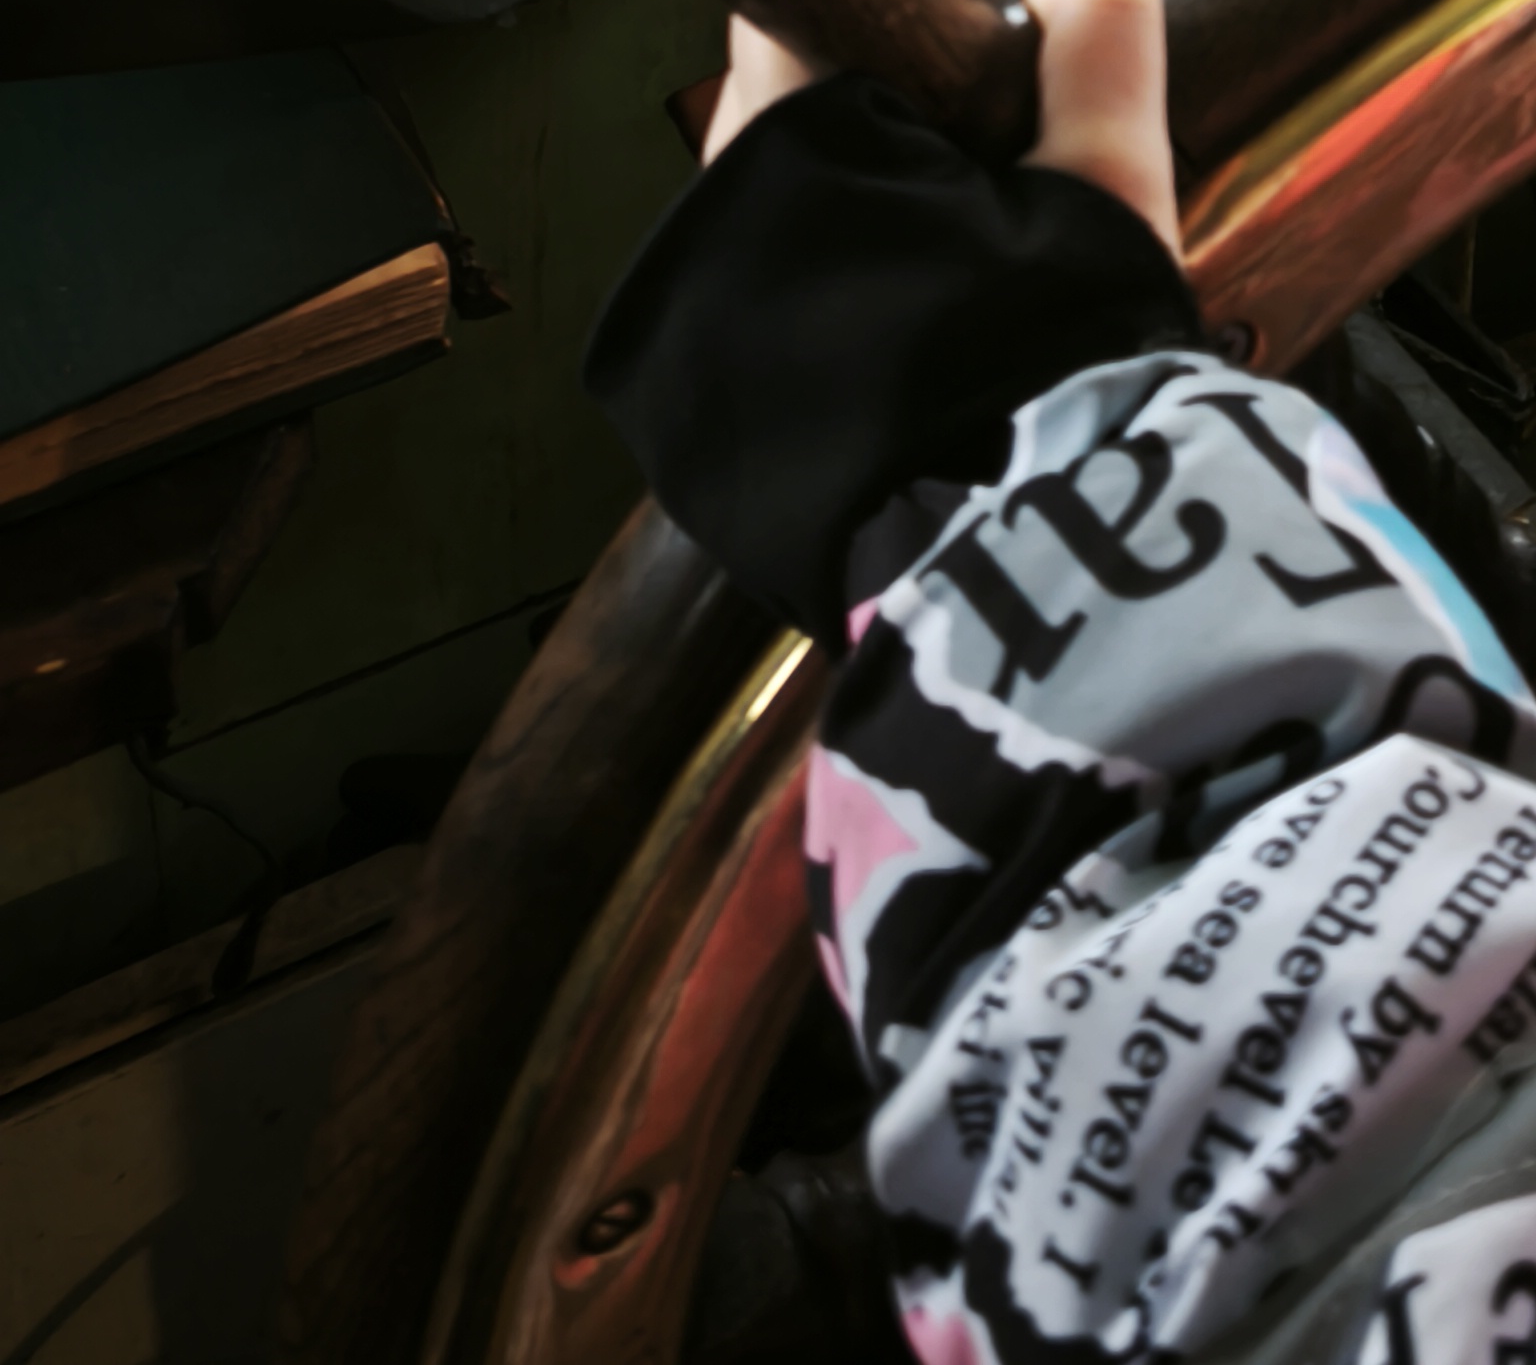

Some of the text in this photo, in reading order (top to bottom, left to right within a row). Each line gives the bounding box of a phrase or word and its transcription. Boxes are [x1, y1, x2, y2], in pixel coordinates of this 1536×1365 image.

[1165, 879, 1261, 986] sea
[1340, 977, 1443, 1087] by
[1058, 997, 1204, 1211] level.
[1170, 1106, 1257, 1212] Le
